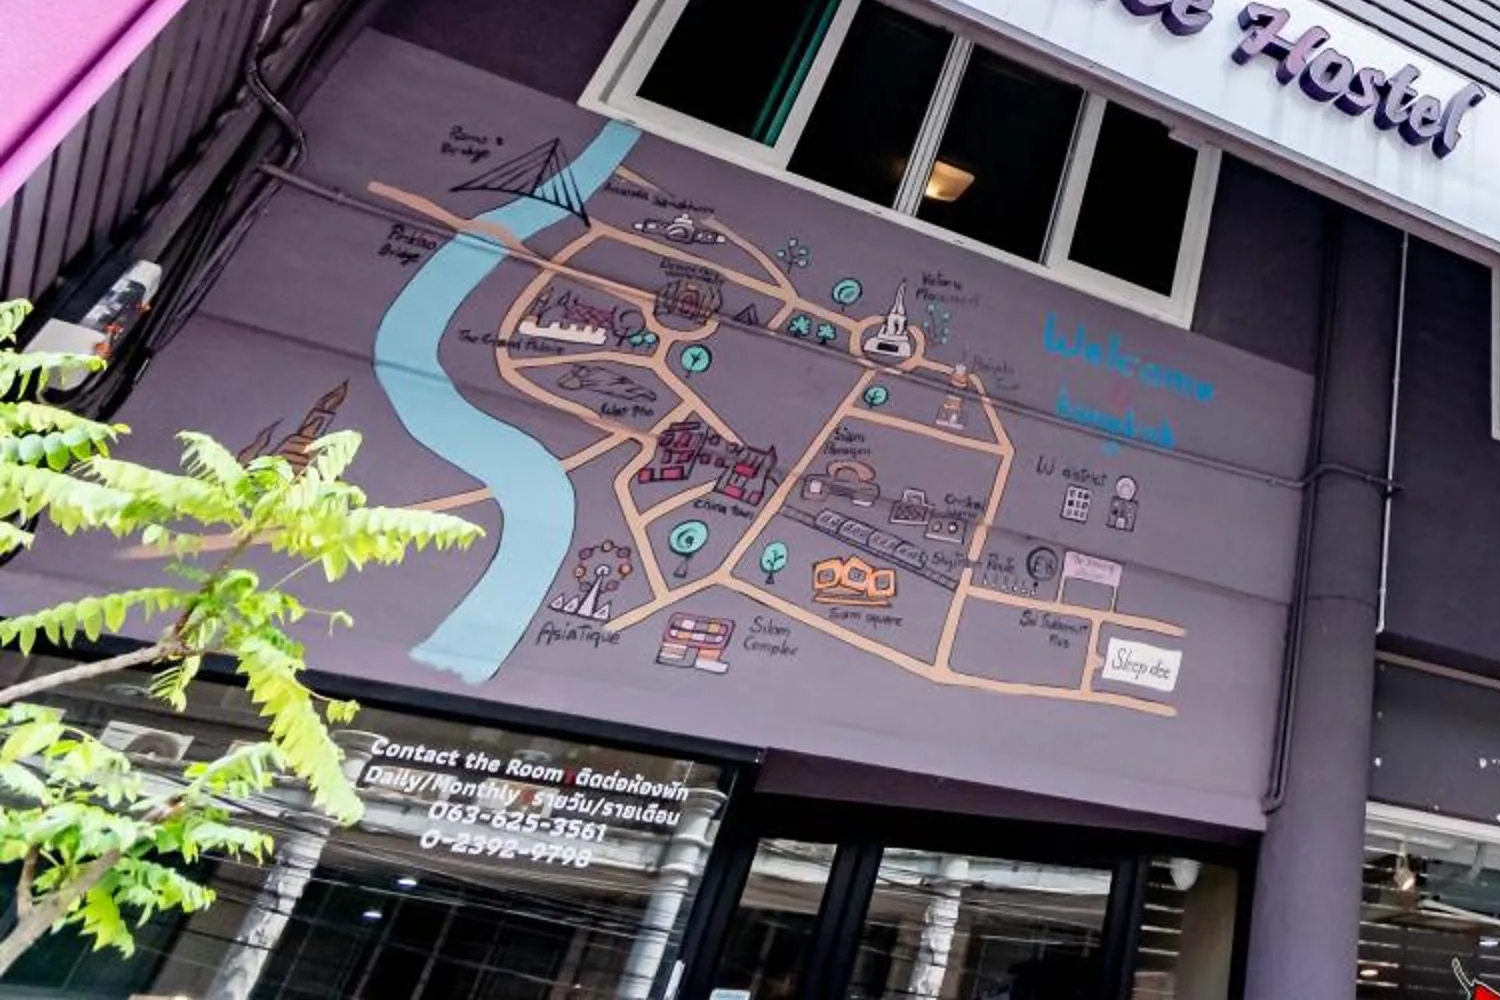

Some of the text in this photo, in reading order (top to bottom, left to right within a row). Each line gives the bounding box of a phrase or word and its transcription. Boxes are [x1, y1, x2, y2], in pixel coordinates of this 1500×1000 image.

[1231, 1, 1486, 159] Hostel
[371, 739, 563, 784] Contact the Room
[363, 765, 521, 808] Daily/Monthly
[428, 803, 607, 842] 063-625-3561
[419, 829, 593, 868] 0-2392-9798
